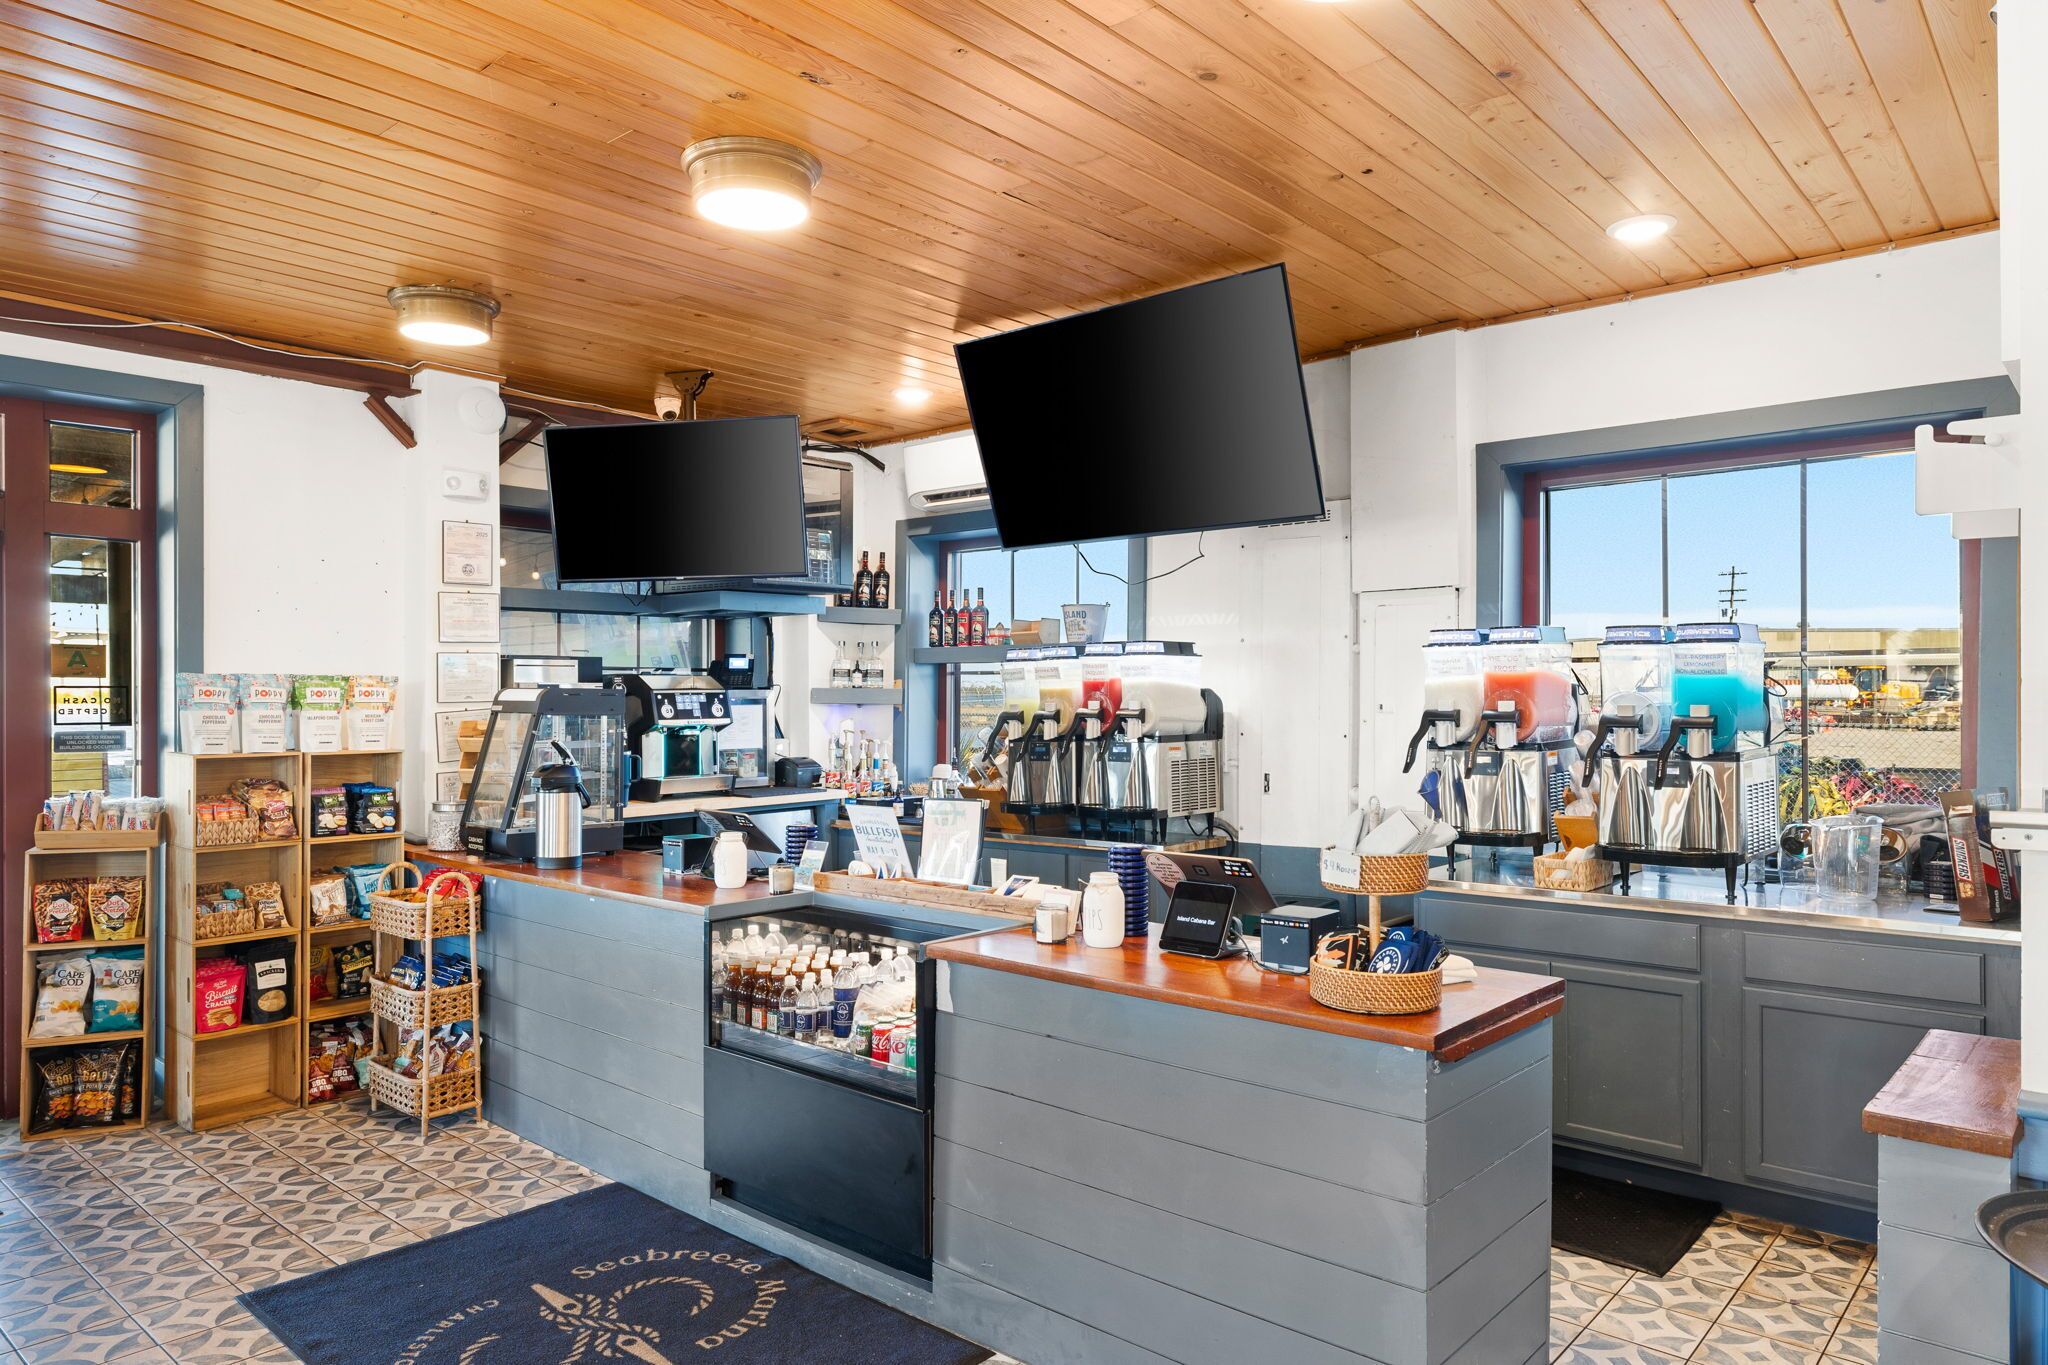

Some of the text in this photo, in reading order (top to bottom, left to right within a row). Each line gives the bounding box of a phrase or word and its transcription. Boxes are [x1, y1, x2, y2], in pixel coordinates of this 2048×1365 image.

[855, 825, 899, 838] BILLFISH
[866, 846, 879, 855] MAY
[1954, 839, 1971, 880] SNICKERS
[1993, 849, 2012, 900] SNICKERS
[1085, 908, 1103, 931] IPS
[1176, 915, 1216, 926] Island Cabana Bar
[57, 969, 86, 979] CAPE
[113, 968, 140, 978] CAPE
[59, 978, 84, 986] COD
[117, 977, 139, 986] COD
[205, 984, 239, 1003] Biscuit
[890, 1036, 906, 1054] ke
[83, 1070, 108, 1082] GOLD
[332, 1069, 348, 1077] BBQ
[56, 1074, 73, 1086] GOL
[311, 1078, 327, 1087] BBQ
[571, 1247, 763, 1279] Seabreeze
[695, 1279, 788, 1350] Marina
[395, 1299, 500, 1365] CHARLESTO
